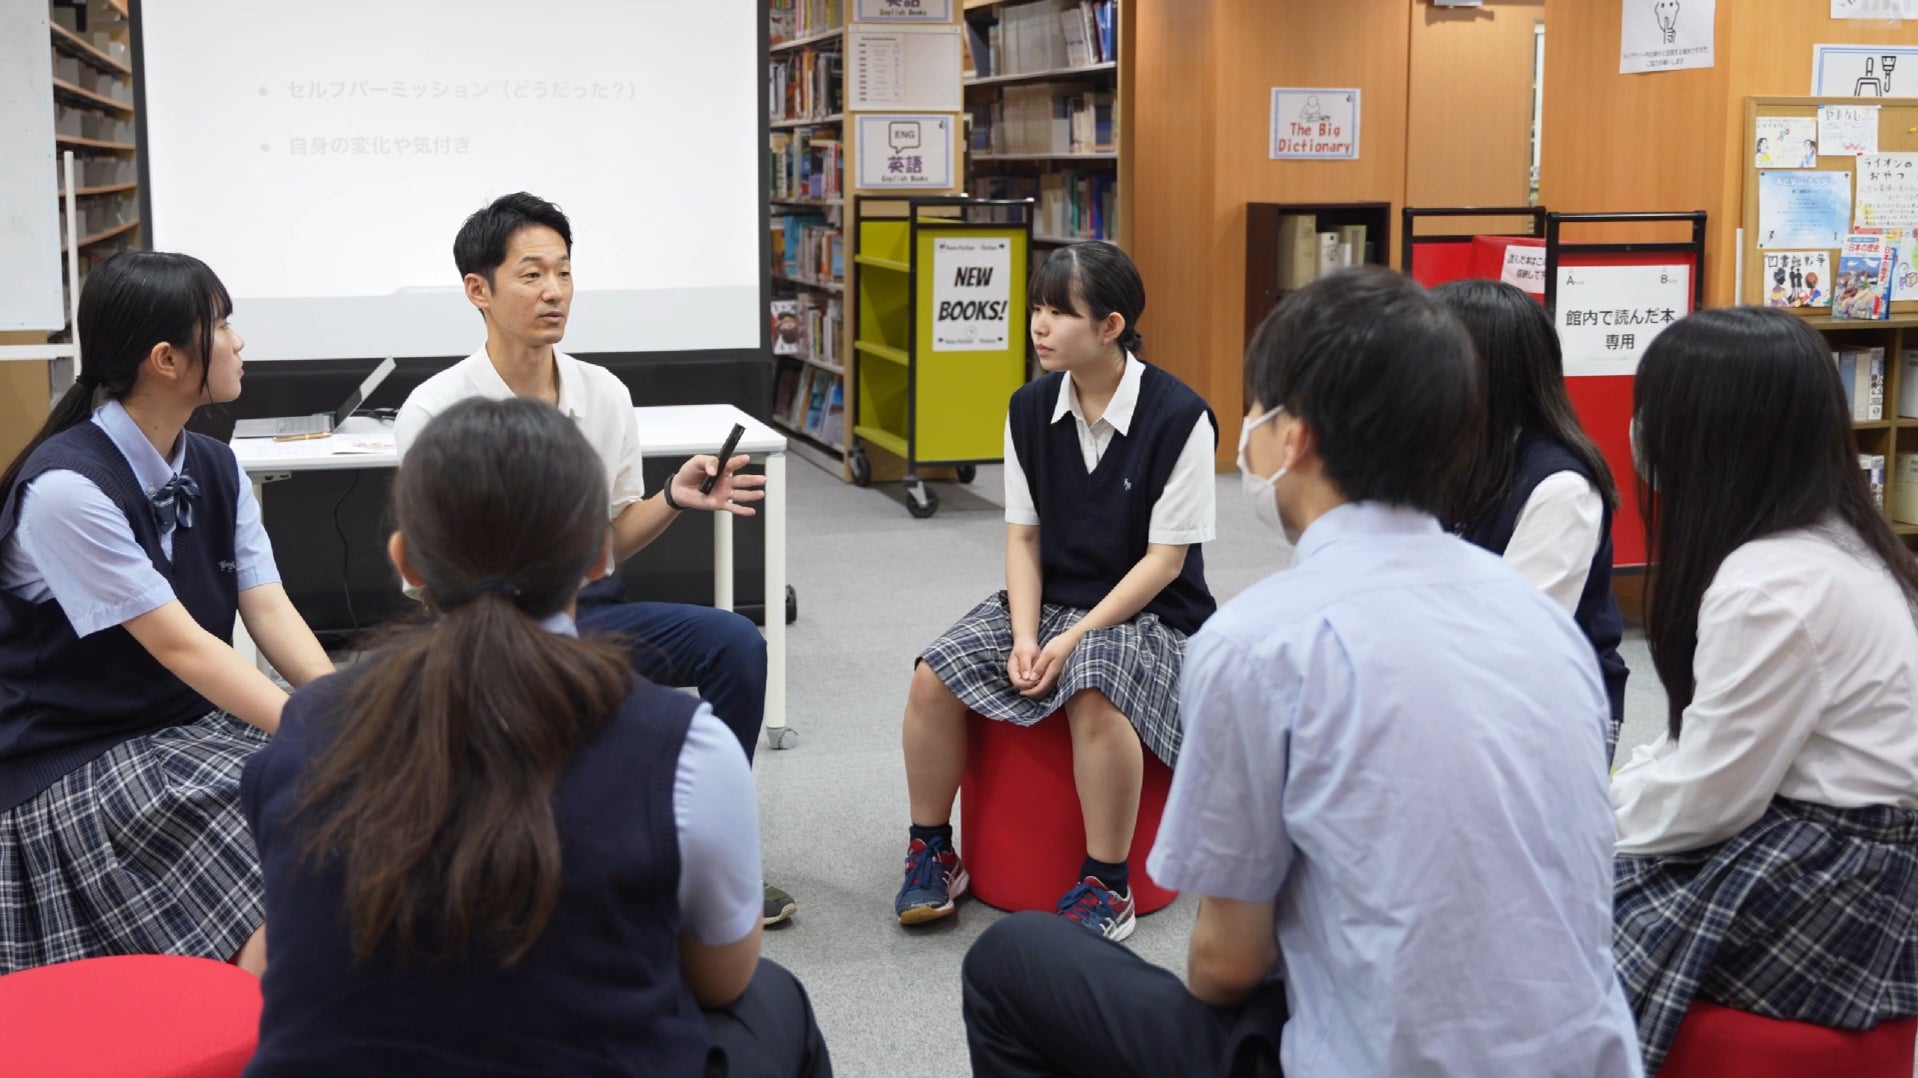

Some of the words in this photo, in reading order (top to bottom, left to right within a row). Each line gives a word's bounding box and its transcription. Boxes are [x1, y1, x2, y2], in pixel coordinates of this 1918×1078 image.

[908, 8, 927, 16] Books
[894, 130, 915, 139] ENG
[1290, 122, 1312, 136] The
[1318, 122, 1341, 137] Big
[288, 135, 471, 155] 自身の変化や気付き
[1278, 138, 1351, 155] Dictionary
[887, 155, 923, 173] 英語
[1864, 157, 1913, 169] ライオンの
[954, 266, 994, 287] NEW
[938, 300, 1008, 322] BOOKS!
[1565, 308, 1676, 326] 館内で読んだ本
[1605, 333, 1635, 350] 専用
